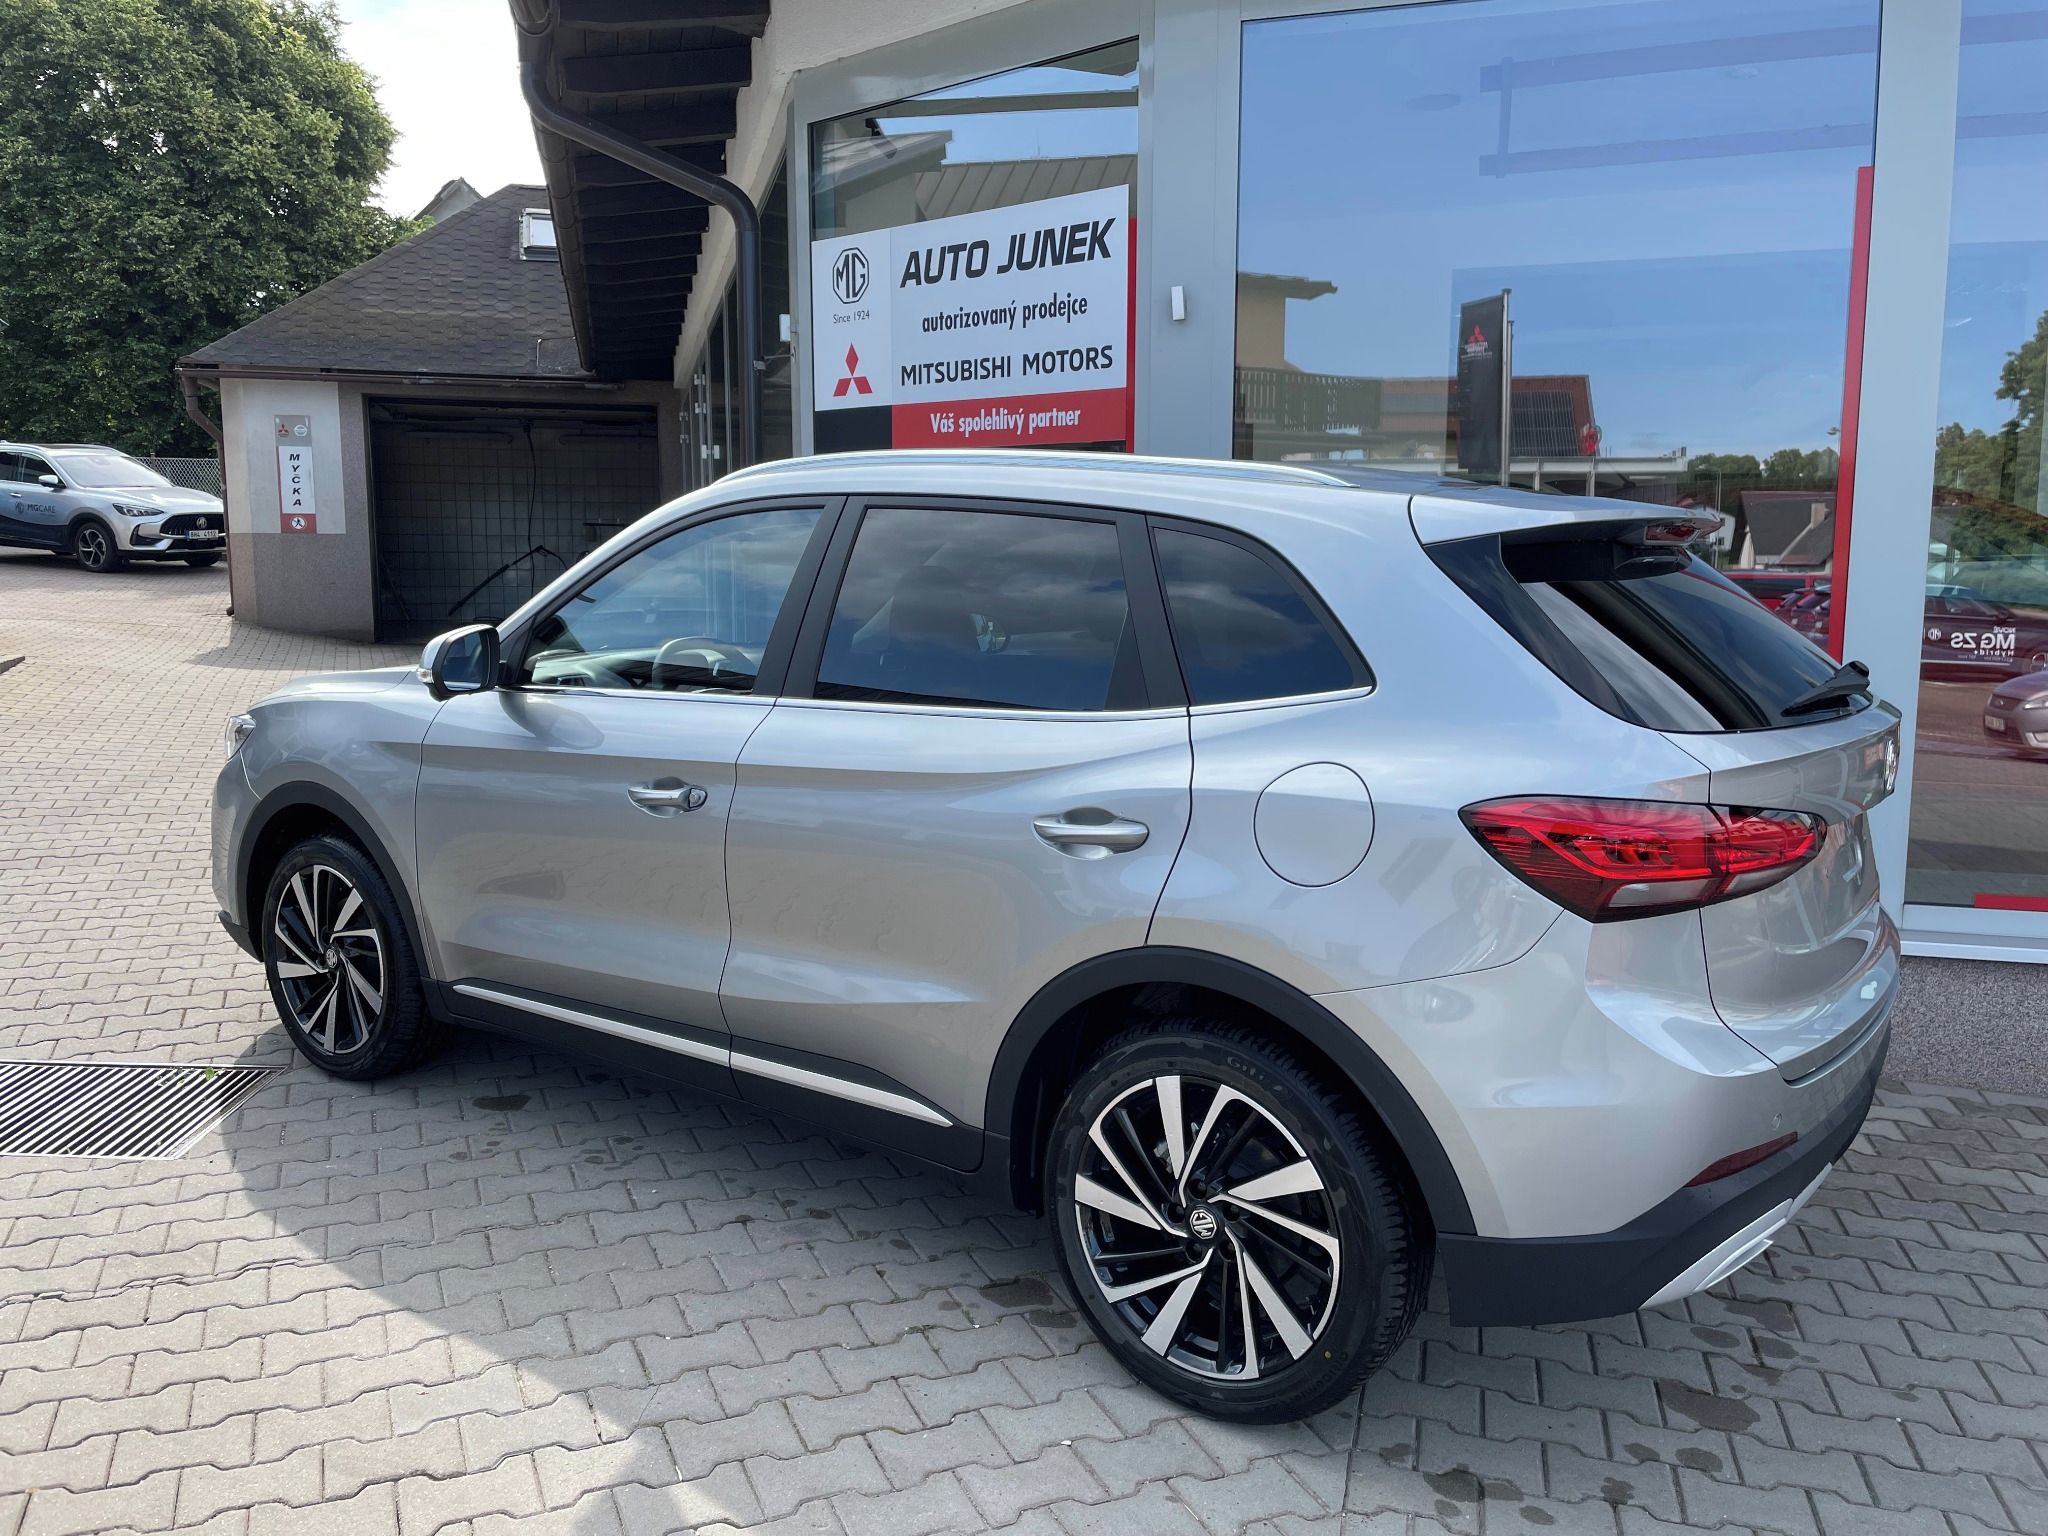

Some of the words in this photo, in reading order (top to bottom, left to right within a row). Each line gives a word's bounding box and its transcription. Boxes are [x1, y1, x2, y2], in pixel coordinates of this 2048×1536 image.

[900, 239, 990, 288] AUTO
[996, 217, 1117, 275] JUNEK
[836, 252, 866, 299] MG
[833, 313, 851, 324] Since
[853, 309, 871, 321] 1924
[922, 300, 1017, 332] autorizovaný
[1022, 292, 1088, 328] prodejce
[901, 355, 1011, 386] MITSUBISHI
[1022, 345, 1113, 376] MOTORS
[930, 412, 955, 434] Váš
[958, 408, 1025, 438] spolehlivý
[1028, 408, 1081, 434] partner
